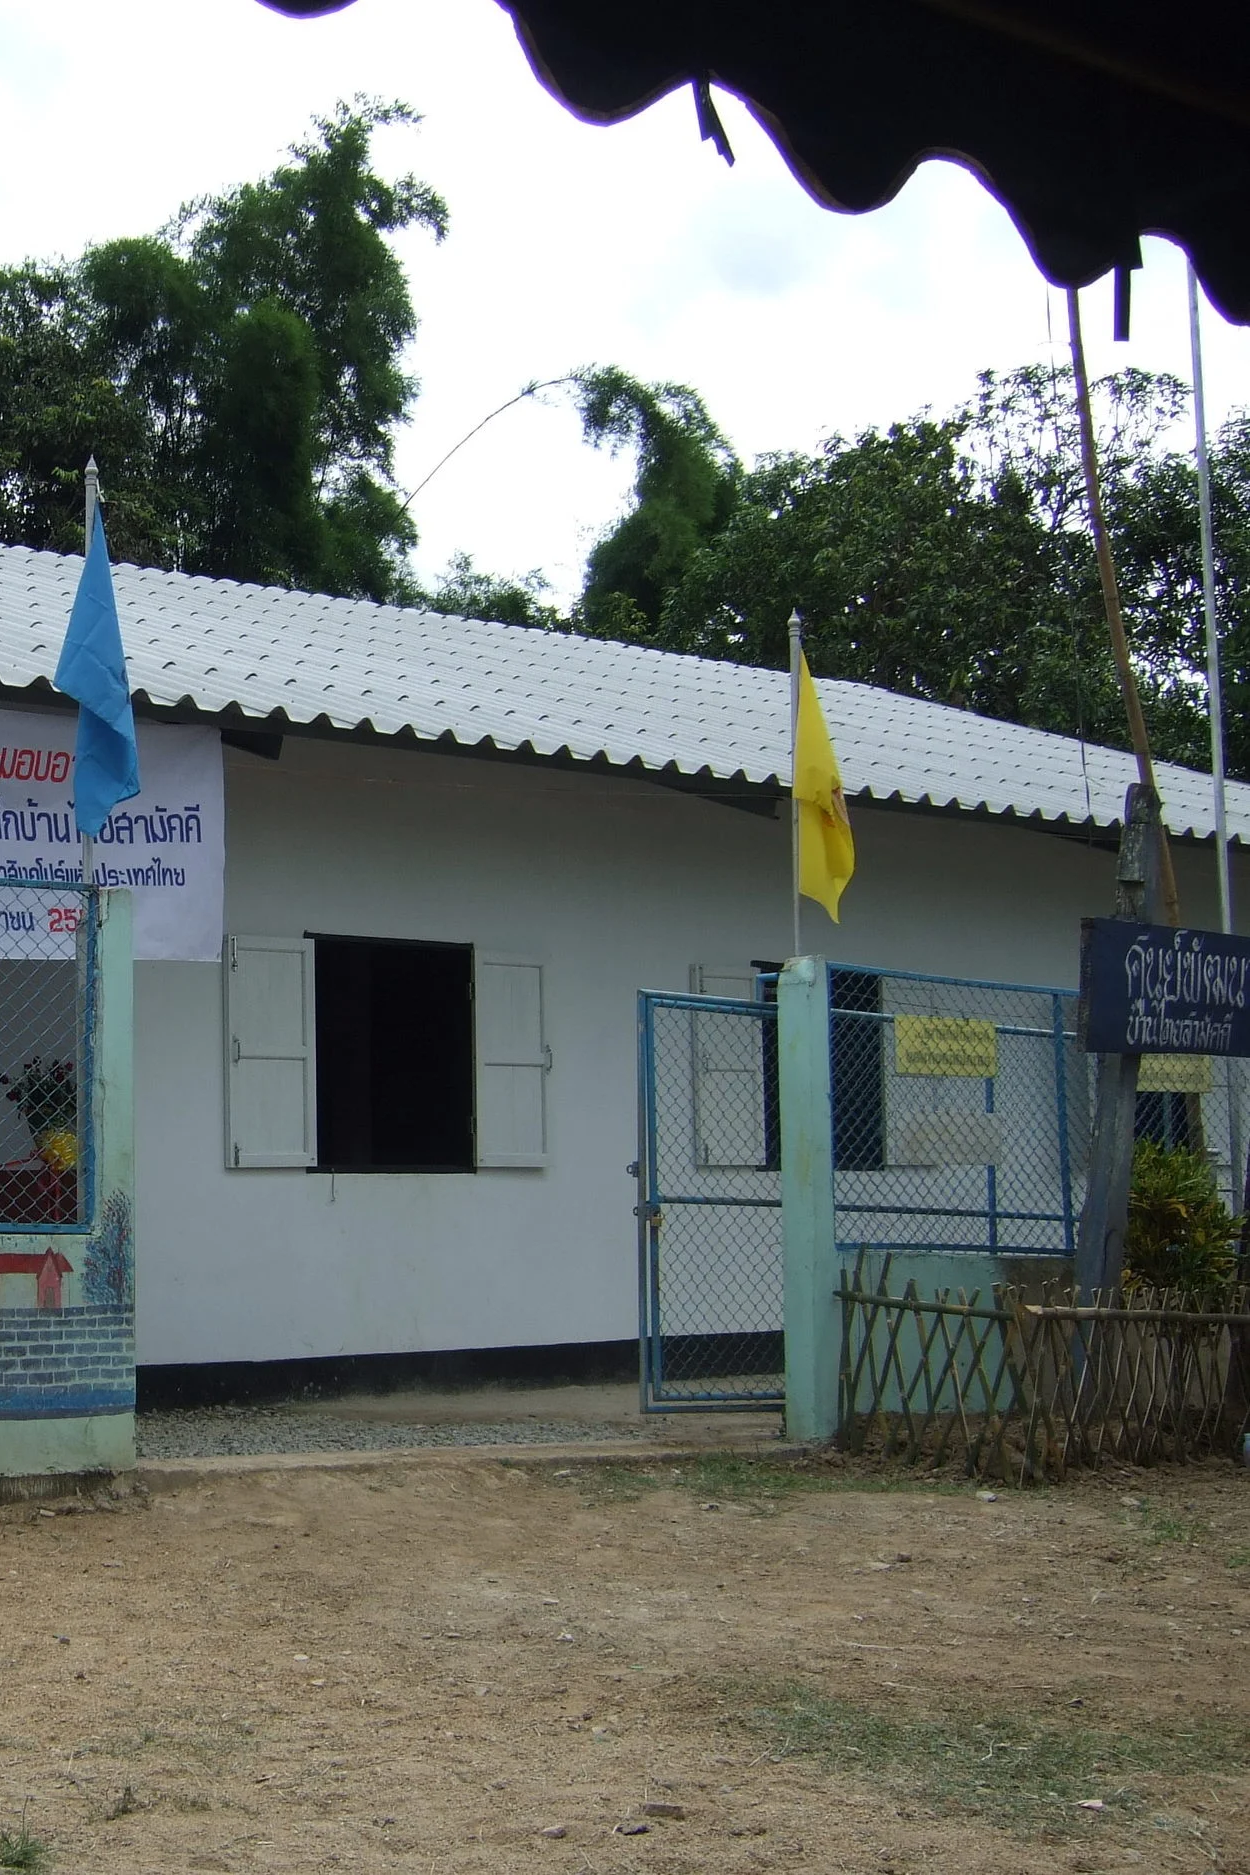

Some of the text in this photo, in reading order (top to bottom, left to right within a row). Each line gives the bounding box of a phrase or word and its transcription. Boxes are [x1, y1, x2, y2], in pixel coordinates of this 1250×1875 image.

[48, 908, 84, 932] 25
[1125, 930, 1250, 1009] ศูนย์พัฒน
